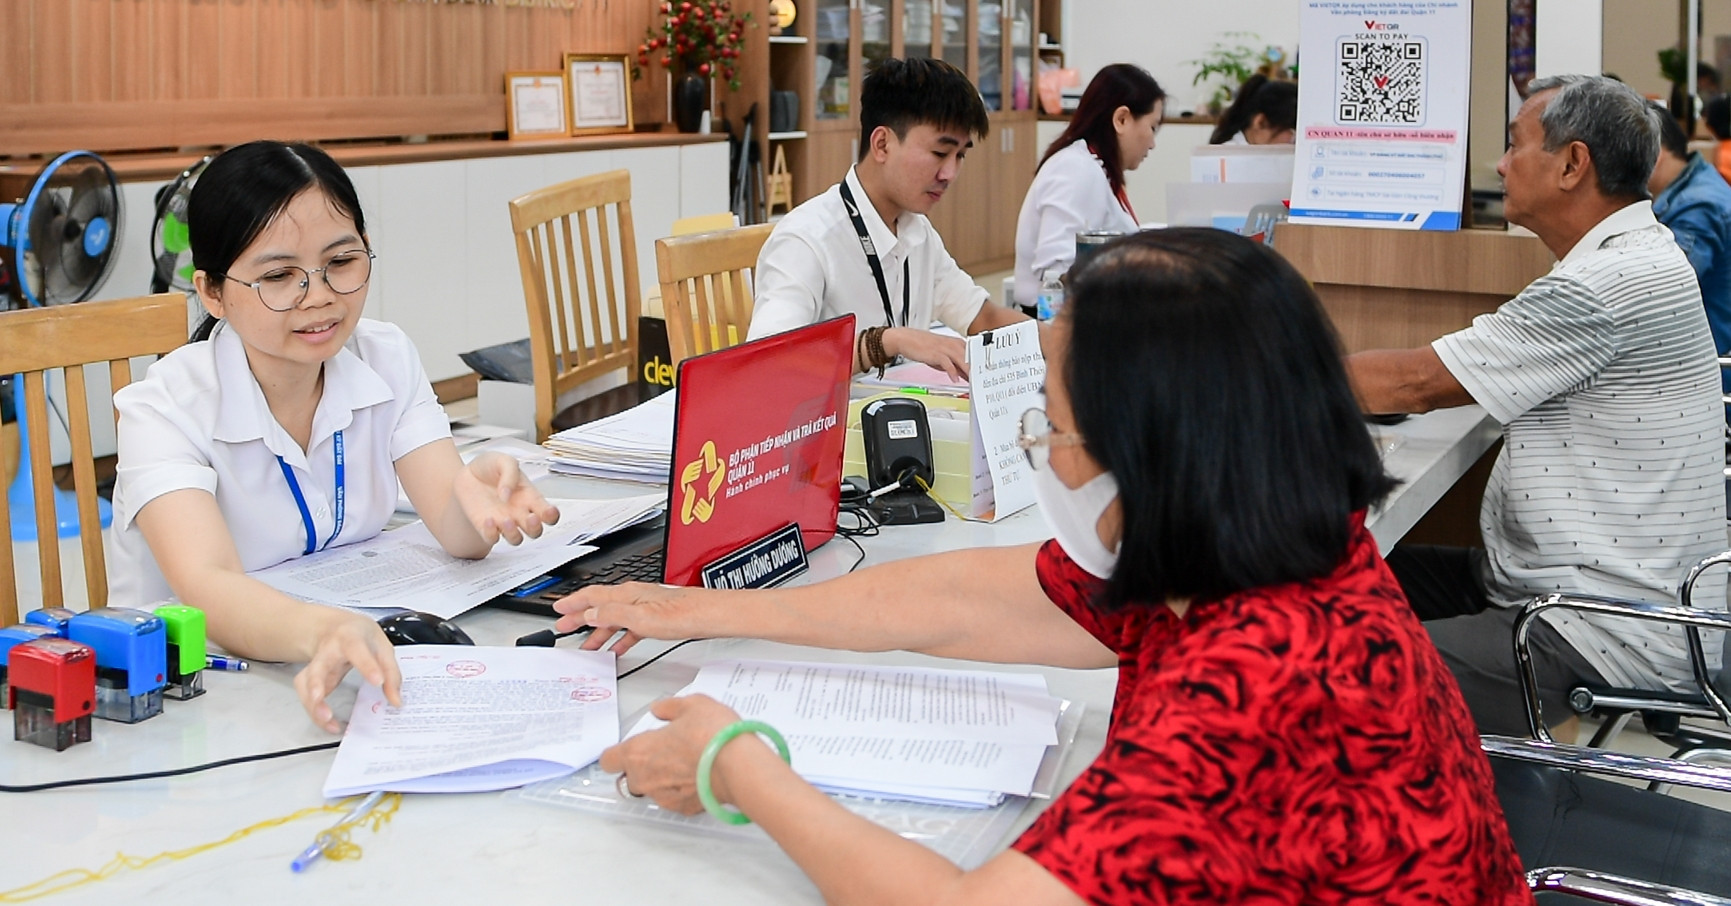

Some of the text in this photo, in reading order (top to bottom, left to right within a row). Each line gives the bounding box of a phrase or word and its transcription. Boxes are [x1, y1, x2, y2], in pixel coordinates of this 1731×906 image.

[728, 448, 740, 468] BỘ
[740, 442, 760, 462] PHẬN
[760, 435, 774, 455] TIẾP
[774, 430, 792, 448] NHẬN
[813, 416, 825, 434] KẾT
[728, 461, 755, 485] QUẬN 11
[770, 540, 799, 569] DƯƠNG
